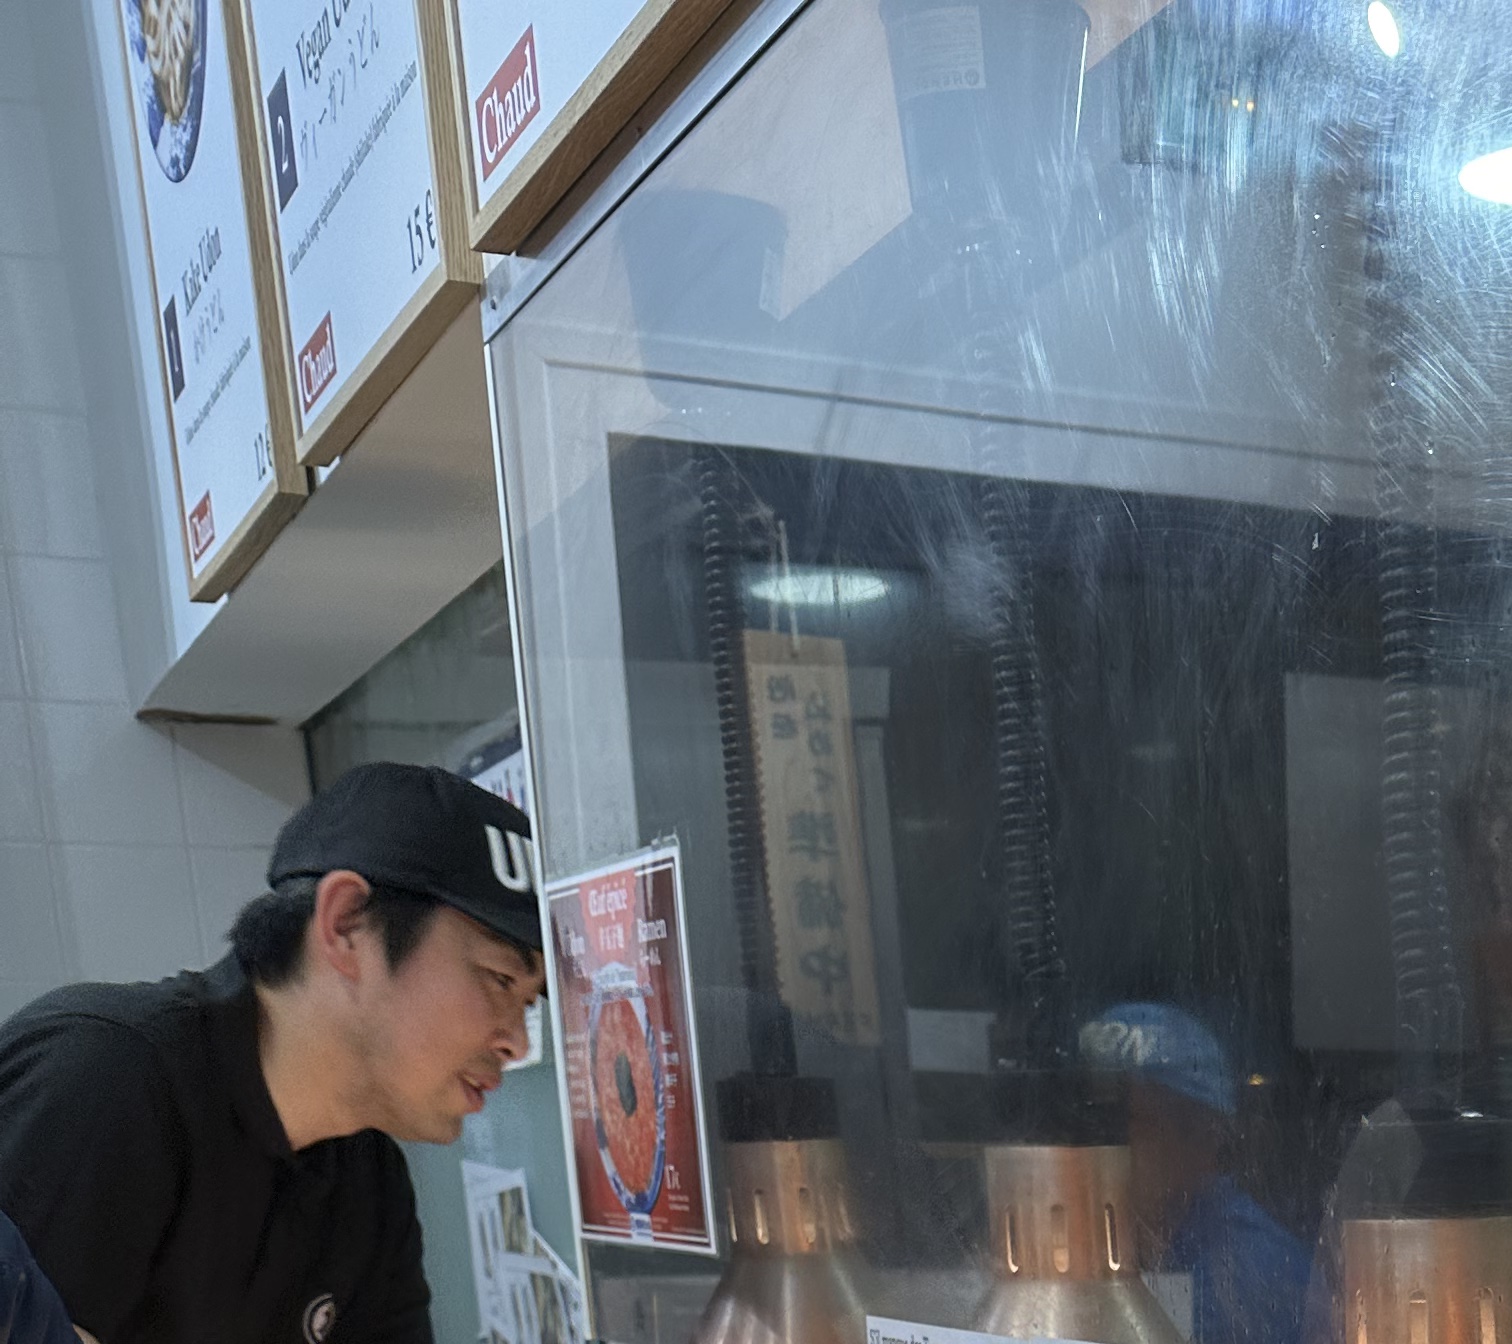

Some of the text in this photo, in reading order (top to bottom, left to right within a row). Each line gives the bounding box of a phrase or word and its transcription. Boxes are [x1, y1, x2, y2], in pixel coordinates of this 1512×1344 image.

[296, 6, 332, 89] Vegan
[482, 41, 536, 163] Chaud
[277, 115, 289, 173] 2
[407, 204, 424, 274] 15
[302, 322, 334, 403] Chaud
